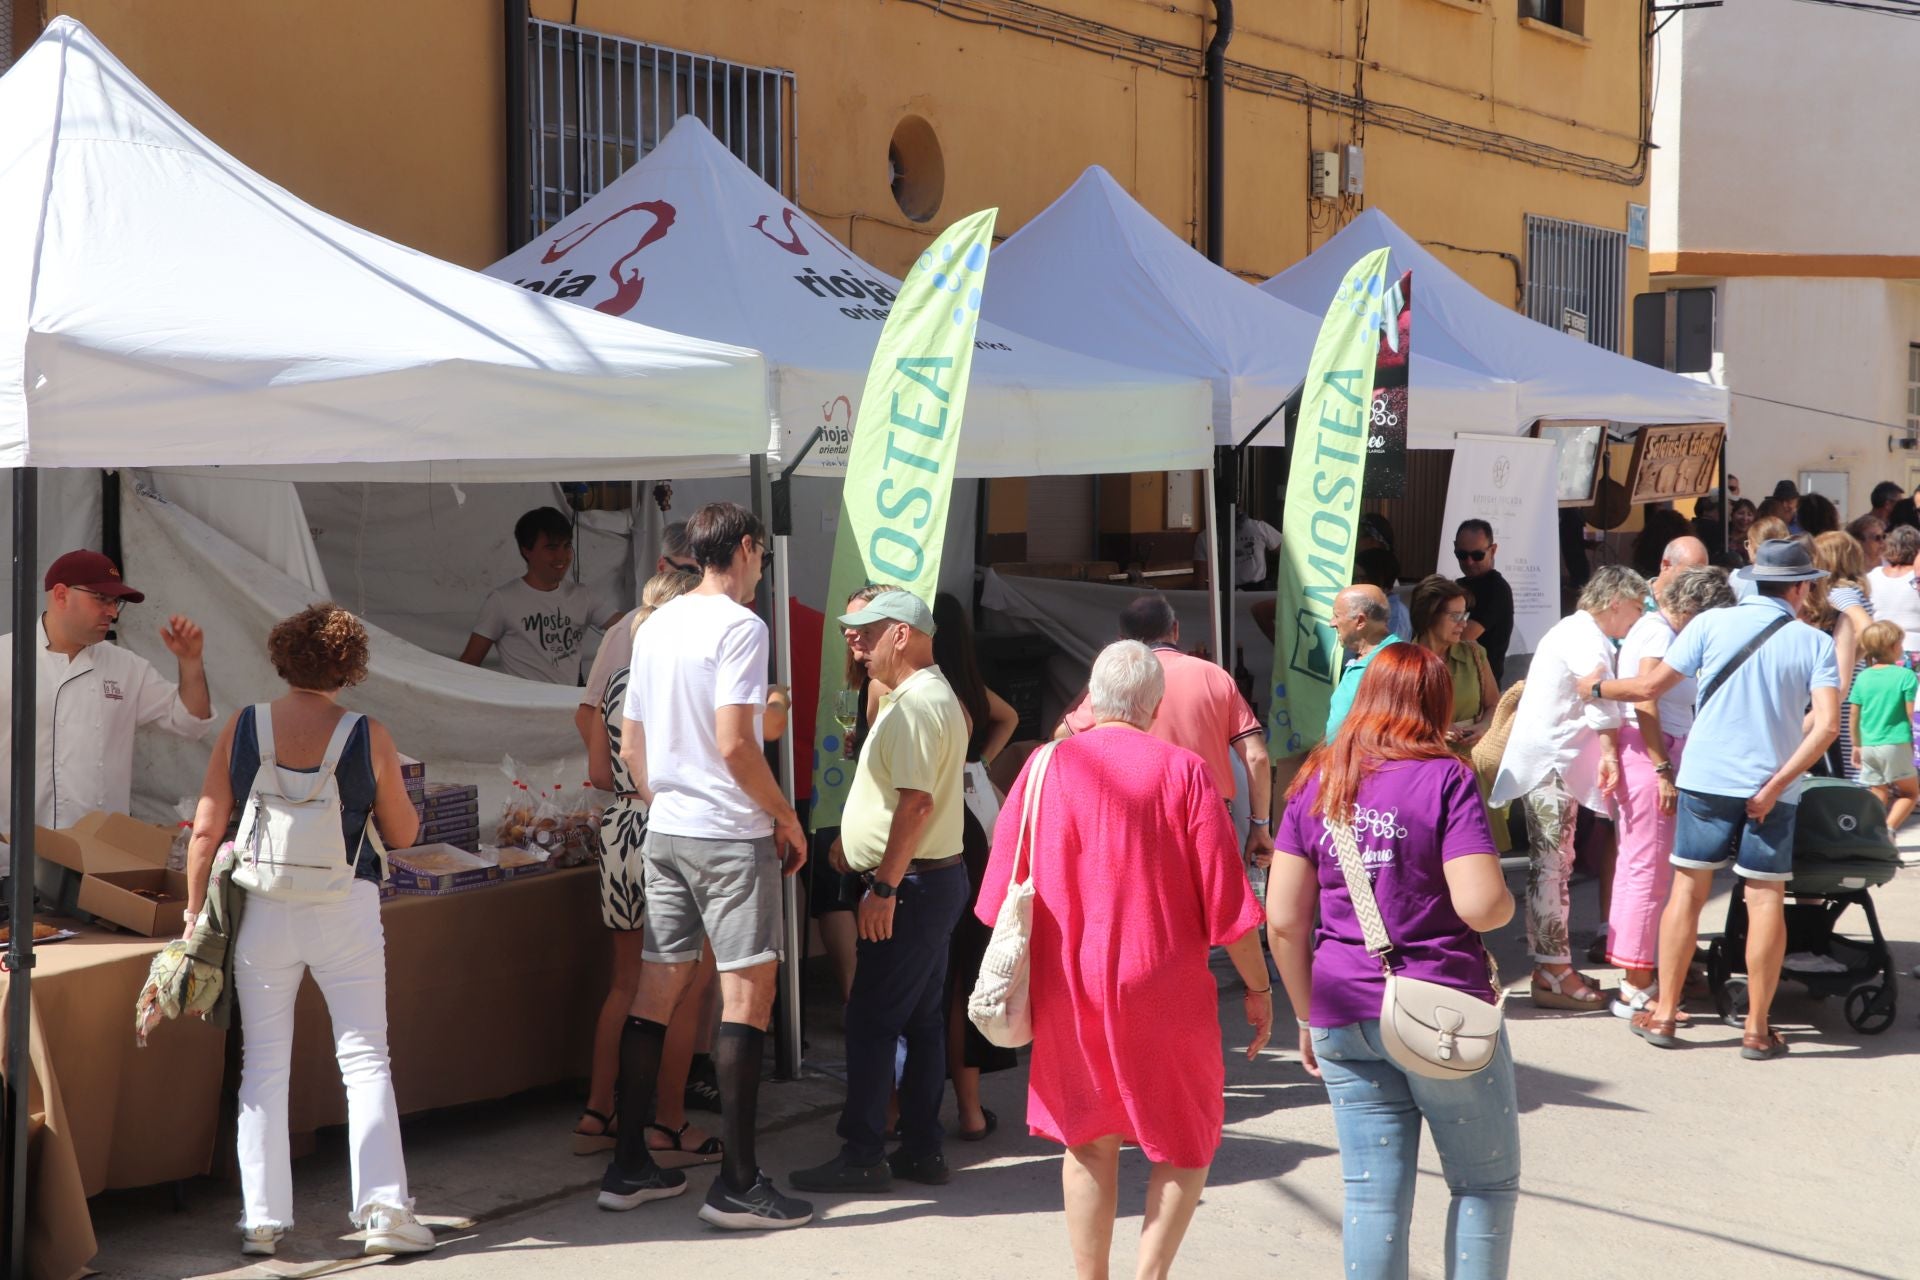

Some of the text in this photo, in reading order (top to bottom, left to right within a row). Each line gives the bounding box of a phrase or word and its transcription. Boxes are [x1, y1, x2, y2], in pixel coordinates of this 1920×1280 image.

[793, 267, 897, 306] rioja
[819, 443, 849, 455] oriental
[866, 356, 954, 586] OSTEA
[1303, 368, 1364, 607] MOSTEA
[521, 606, 571, 651] Mosto
